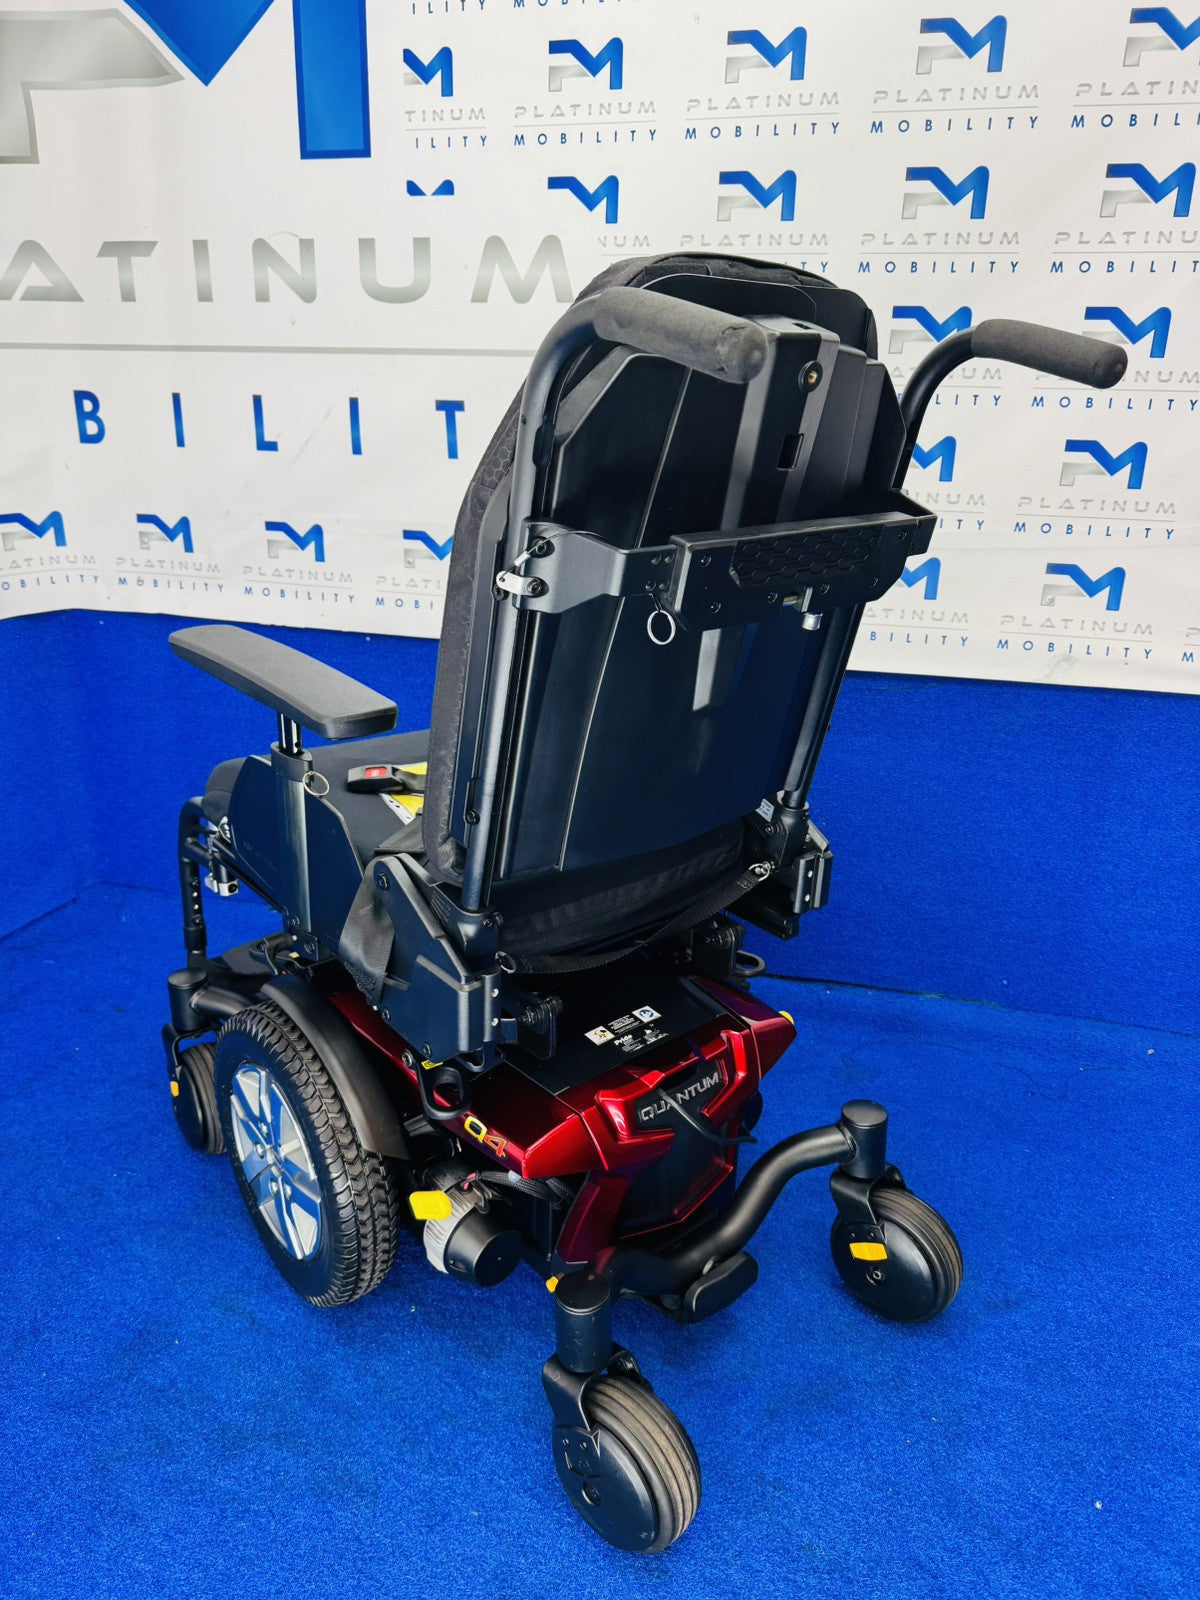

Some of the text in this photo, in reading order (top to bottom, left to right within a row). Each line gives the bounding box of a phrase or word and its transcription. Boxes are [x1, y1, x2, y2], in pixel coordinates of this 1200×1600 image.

[872, 84, 1039, 104] PLATINUM
[1075, 80, 1199, 97] PLATIN
[514, 101, 656, 119] PLATINUM
[686, 91, 840, 112] PLATINUM
[405, 108, 486, 122] TINUM
[685, 122, 840, 141] MOBILITY
[870, 115, 1039, 134] MOBILITY
[415, 135, 487, 149] ILITY
[514, 129, 656, 146] MOBILITY
[680, 233, 829, 247] PLATINUM
[860, 232, 1019, 246] PLATINUM
[1054, 230, 1198, 245] PLATINU
[0, 235, 573, 304] ATINUM
[858, 261, 1019, 274] MOBILITY
[1050, 260, 1199, 273] MOBILIT
[1031, 396, 1199, 411] MOBILITY
[74, 390, 465, 459] BILIT
[1017, 496, 1176, 514] PLATINUM
[1014, 522, 1174, 540] MOBILITY
[0, 555, 97, 570] ATINUM
[115, 557, 221, 573] PLATINUM
[243, 566, 354, 583] PLATINUM
[376, 575, 441, 590] PLATI
[118, 576, 224, 592] MOBILITY
[244, 586, 355, 603] MOBILITY
[375, 597, 434, 610] MOBI
[863, 607, 969, 623] ATINUM
[1000, 614, 1153, 636] PLATINUM
[870, 631, 968, 646] BILITY
[997, 638, 1152, 660] MOBILITY
[464, 1115, 508, 1157] Q4
